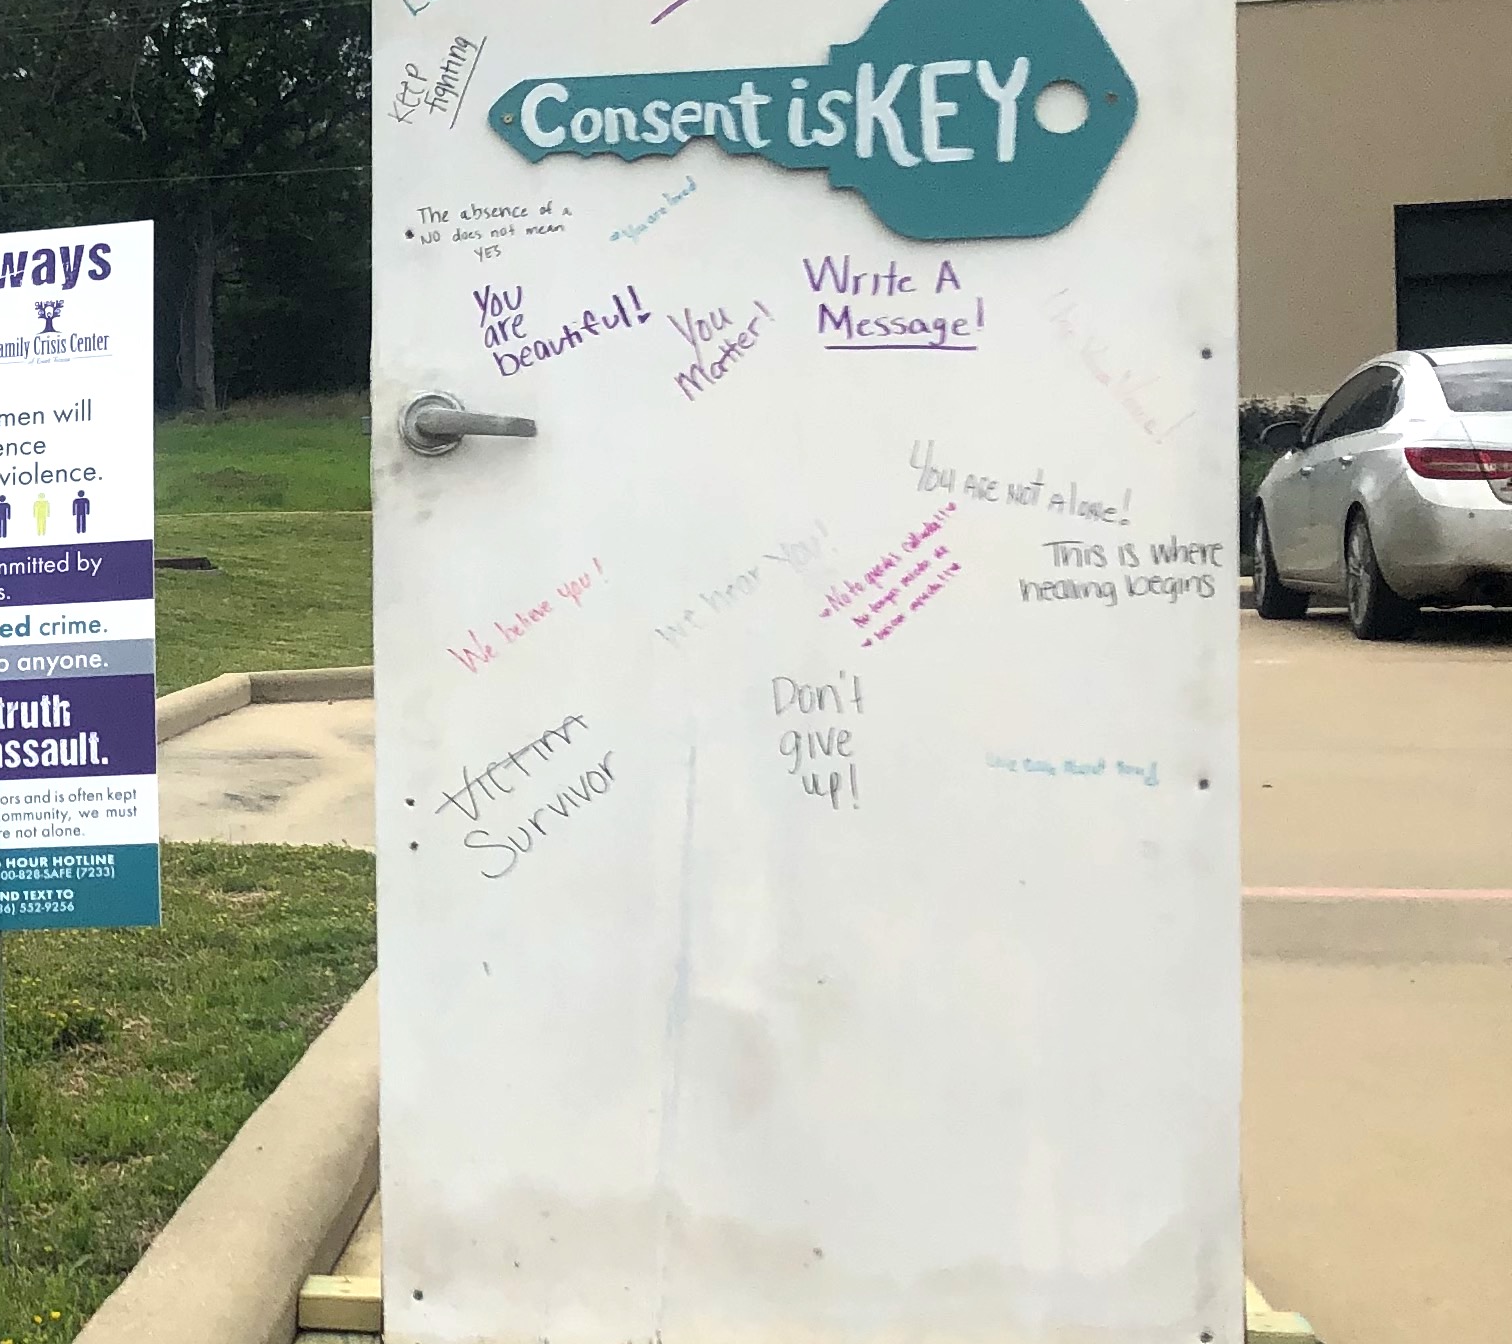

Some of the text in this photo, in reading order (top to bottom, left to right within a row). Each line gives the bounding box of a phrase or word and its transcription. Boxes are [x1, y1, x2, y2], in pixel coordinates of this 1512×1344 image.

[521, 56, 1029, 167] Consent is KEY
[418, 201, 553, 223] The absence of
[453, 227, 481, 242] does
[490, 226, 515, 239] not
[526, 224, 565, 236] mean
[802, 255, 961, 296] Write A
[484, 312, 528, 349] are
[492, 285, 651, 377] beautiful!
[818, 297, 985, 346] Message!
[34, 335, 66, 355] Crisis
[70, 333, 109, 352] Center
[53, 399, 91, 423] will
[0, 462, 103, 486] violence.
[77, 552, 102, 577] by
[1042, 540, 1107, 567] This
[1150, 535, 1223, 567] where
[1125, 574, 1215, 604] begins
[39, 615, 108, 637] crime.
[18, 652, 109, 675] anyone.
[447, 630, 500, 673] We
[772, 670, 864, 716] Don't
[779, 726, 852, 775] give
[24, 790, 51, 803] and
[55, 790, 65, 802] is
[69, 788, 103, 801] often
[107, 788, 136, 801] kept
[800, 764, 860, 809] up!
